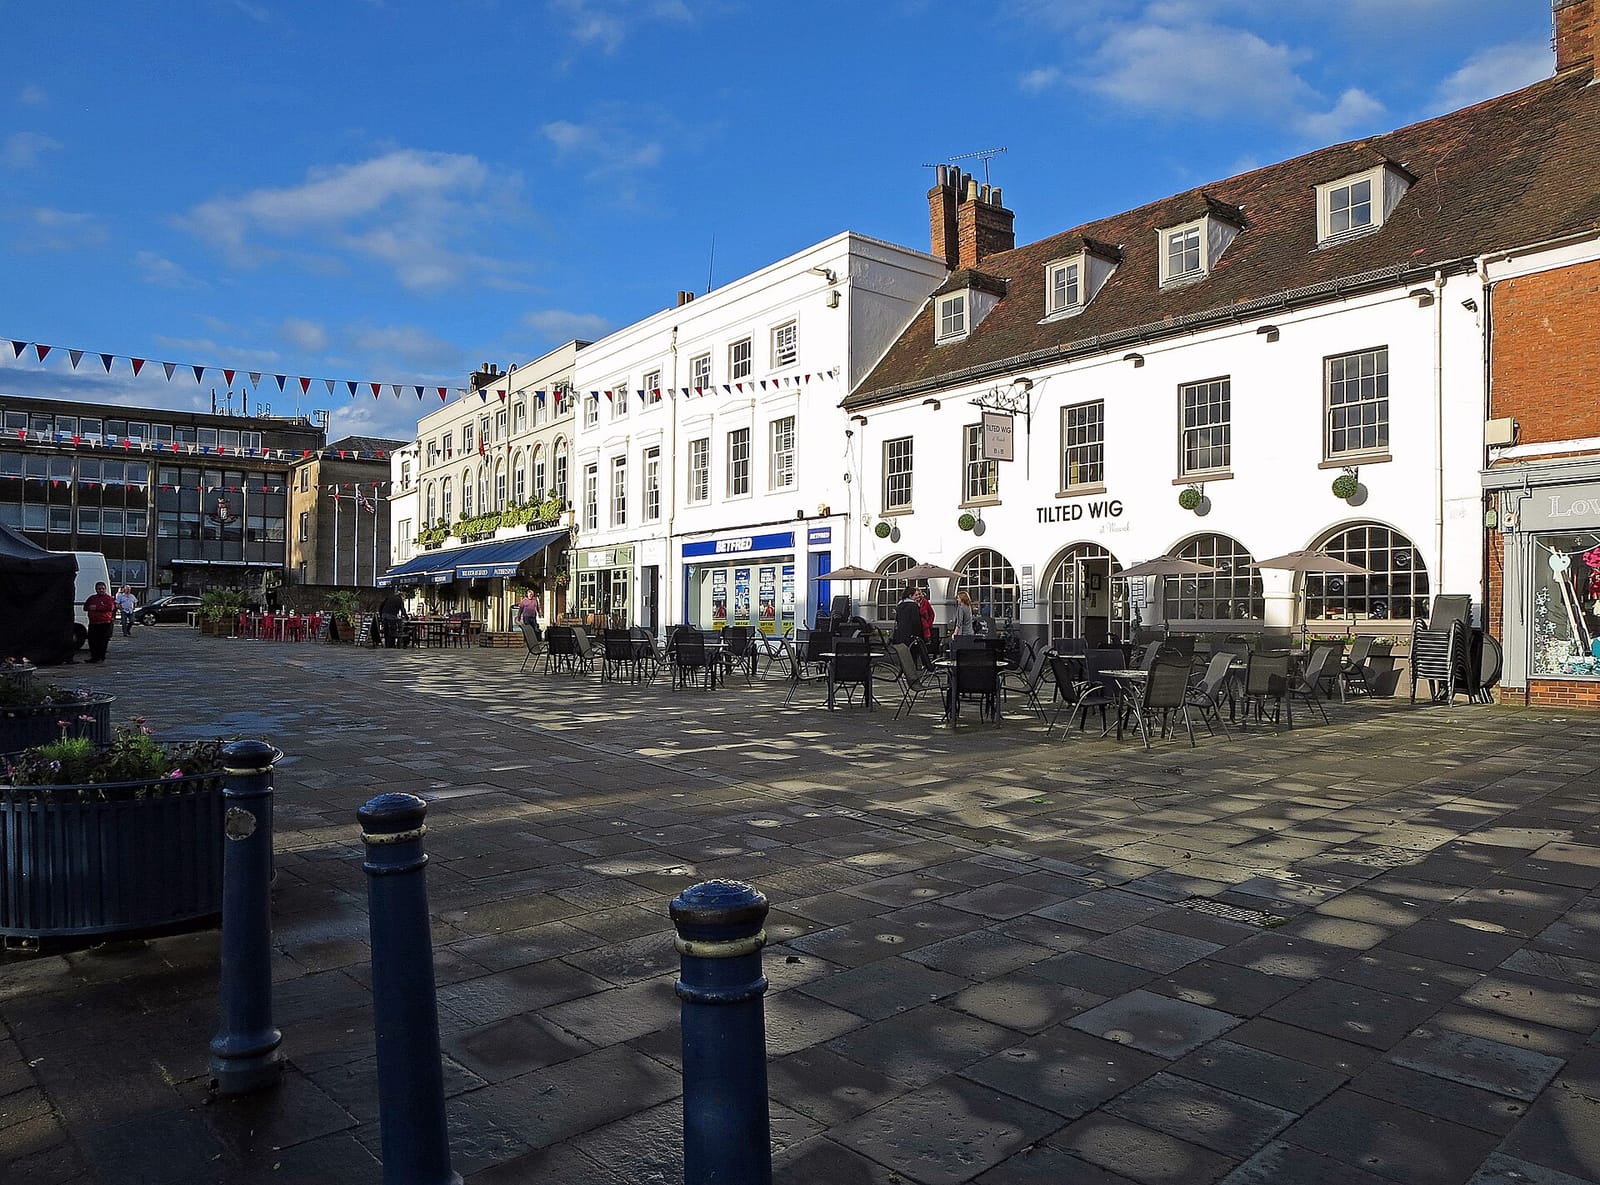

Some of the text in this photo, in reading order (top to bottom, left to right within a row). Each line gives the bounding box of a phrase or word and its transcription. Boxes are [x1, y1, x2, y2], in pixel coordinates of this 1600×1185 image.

[1036, 499, 1123, 524] TILTED WIG
[715, 537, 753, 554] BETFRED
